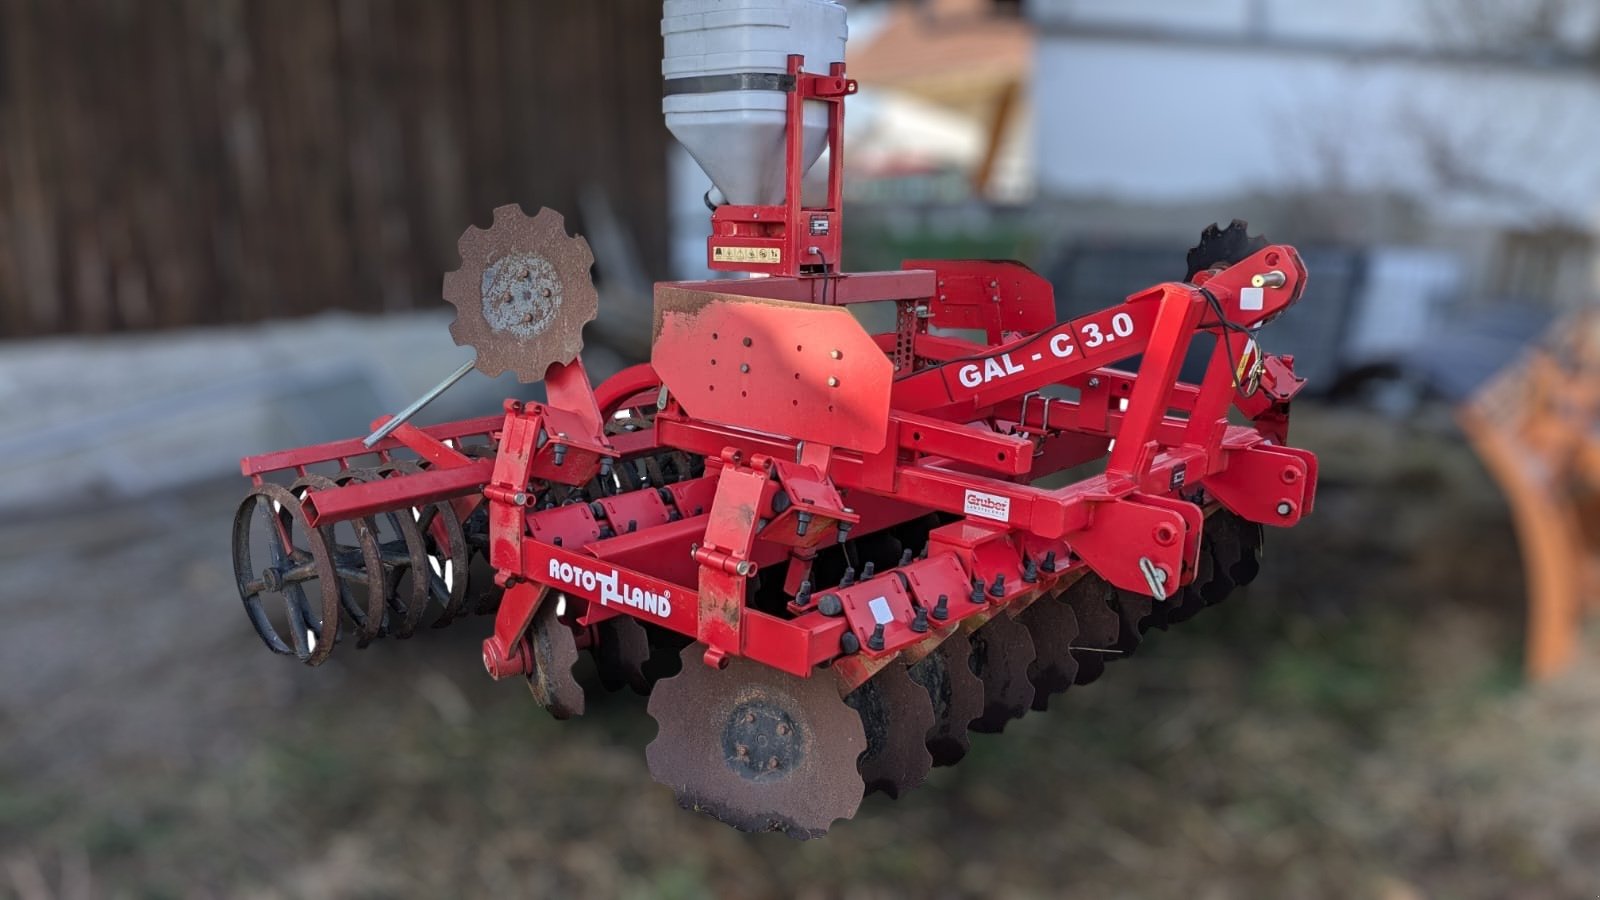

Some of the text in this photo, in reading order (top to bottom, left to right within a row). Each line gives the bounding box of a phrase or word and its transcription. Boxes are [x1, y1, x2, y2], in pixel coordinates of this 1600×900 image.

[959, 354, 1024, 388] GAL
[1050, 333, 1074, 358] C
[1081, 313, 1134, 348] 3.0
[549, 558, 596, 591] ROTO
